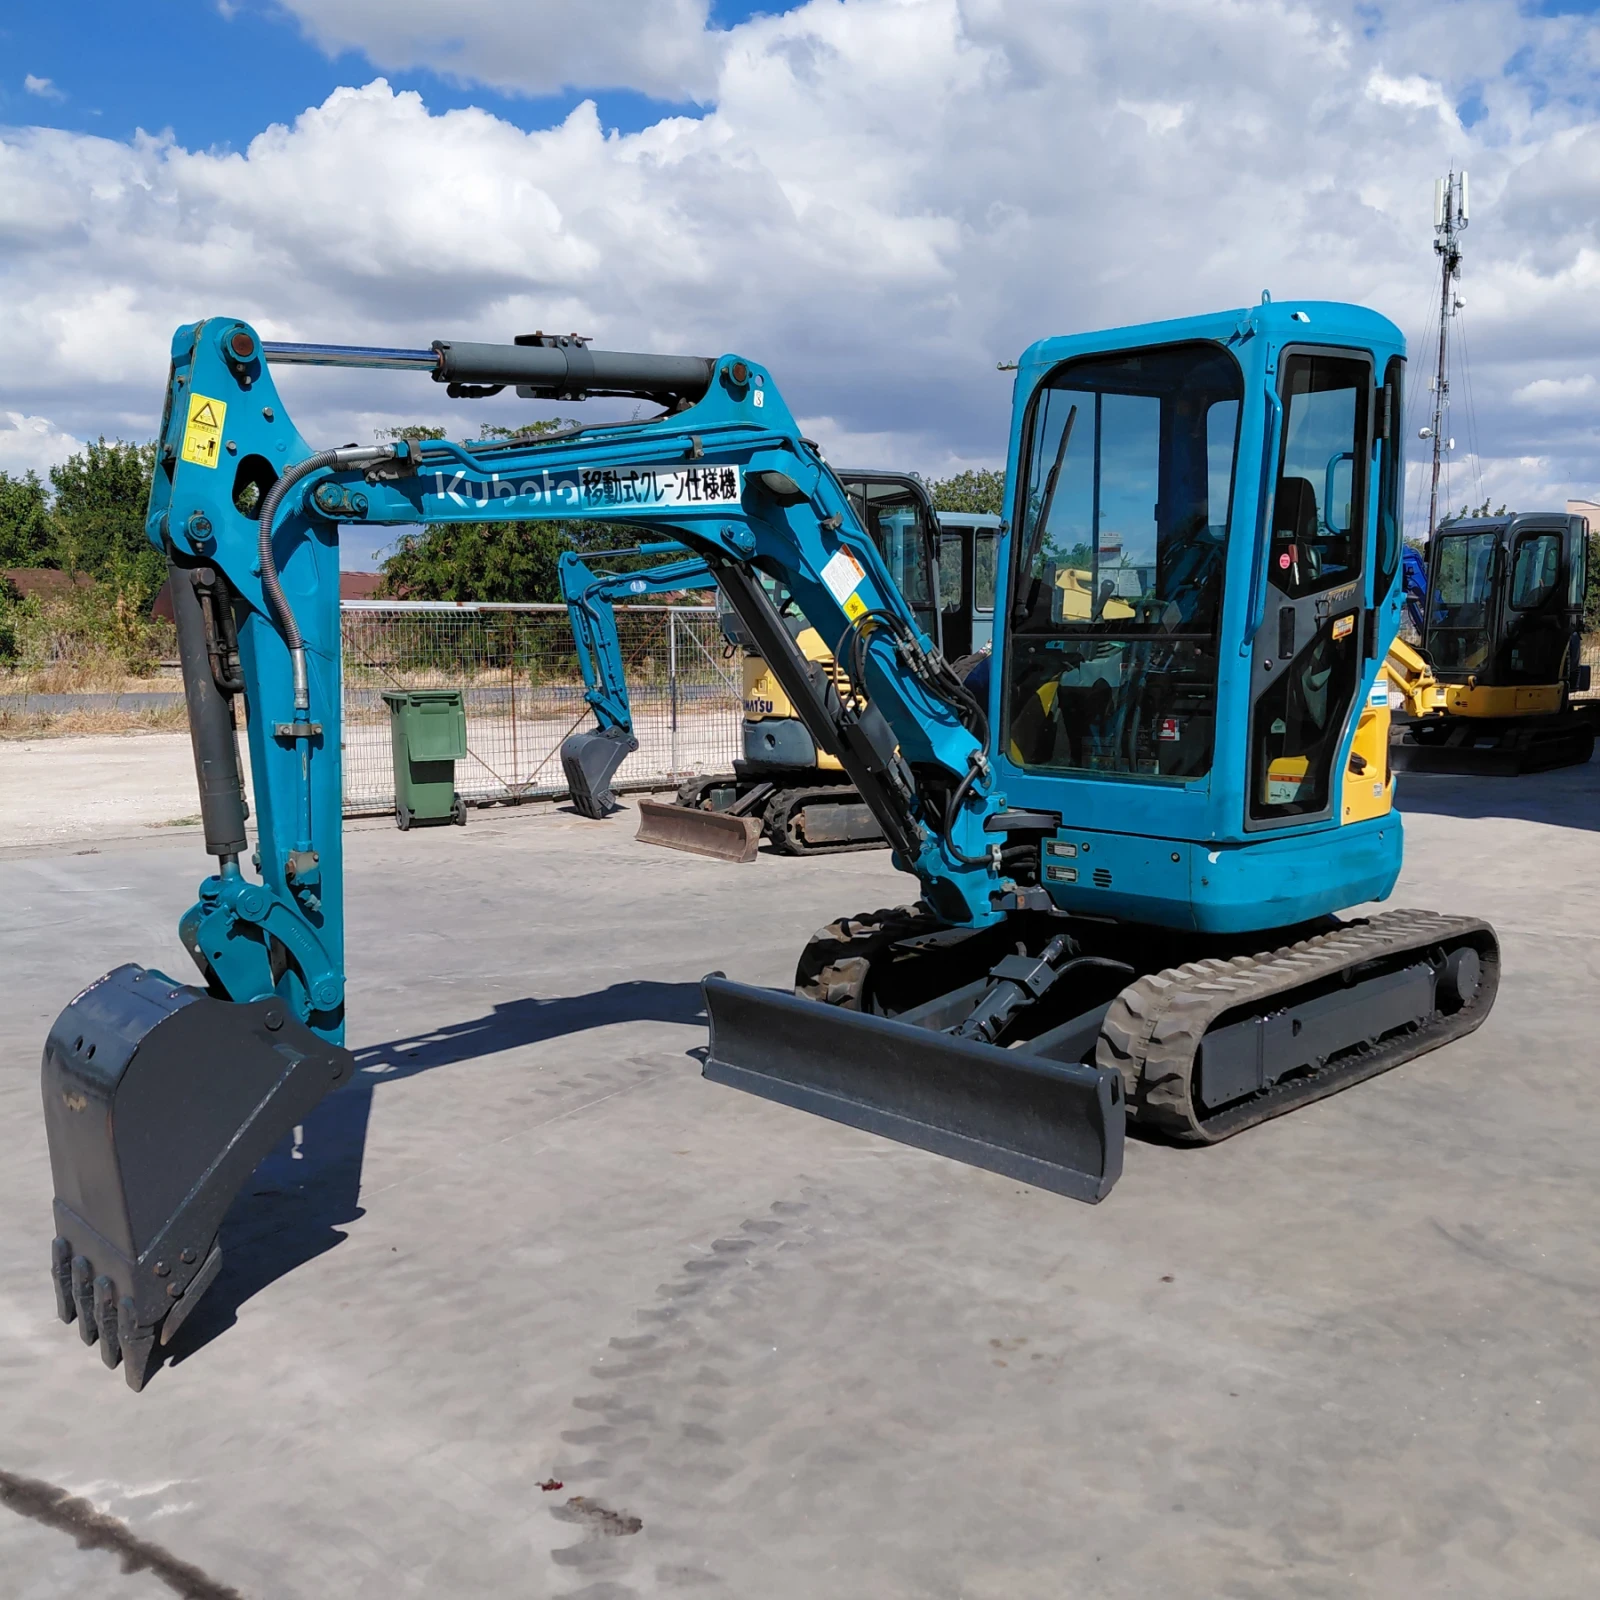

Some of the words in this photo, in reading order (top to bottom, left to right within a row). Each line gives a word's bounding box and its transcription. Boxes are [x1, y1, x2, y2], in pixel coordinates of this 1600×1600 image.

[435, 470, 579, 508] Kubota
[582, 468, 737, 506] 移動式クレーン仕様機
